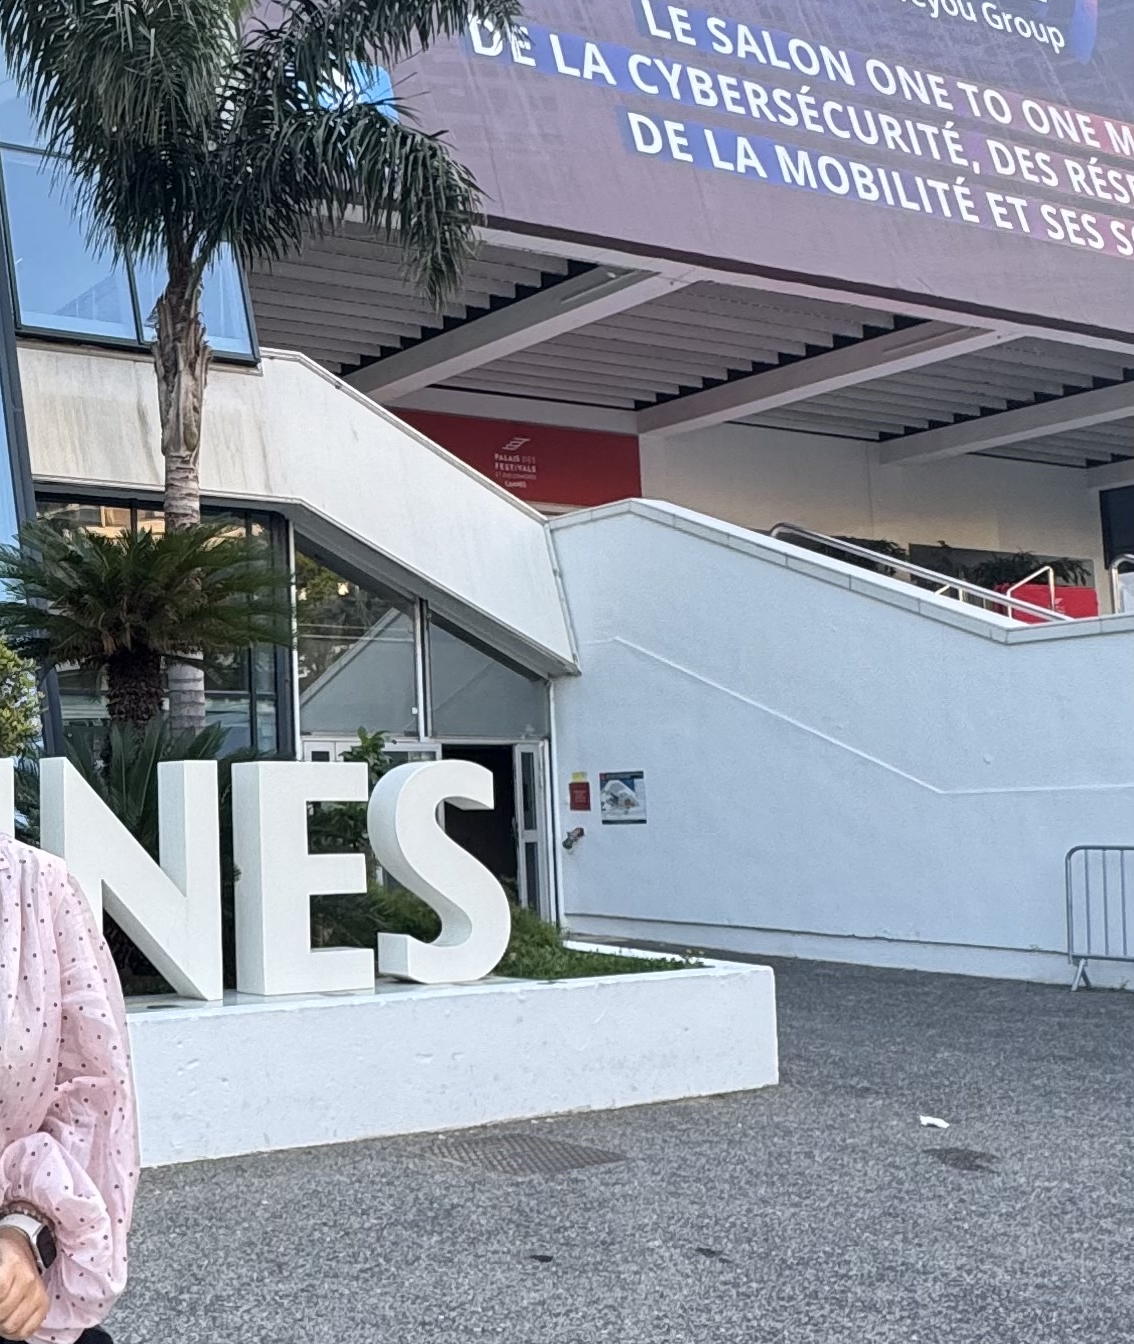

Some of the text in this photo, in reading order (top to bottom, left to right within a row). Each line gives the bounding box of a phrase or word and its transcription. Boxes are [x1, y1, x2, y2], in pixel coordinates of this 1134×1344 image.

[706, 17, 856, 86] SALON
[865, 58, 954, 111] ONE
[956, 81, 1013, 125] TO
[1022, 99, 1102, 149] ONE
[981, 2, 1066, 55] Group
[549, 33, 618, 86] LA
[627, 53, 980, 175] CYBERSÉCURITÉ,
[986, 138, 1059, 187] DES
[627, 111, 1134, 256] DE LA MOBILITÉ ET SES S
